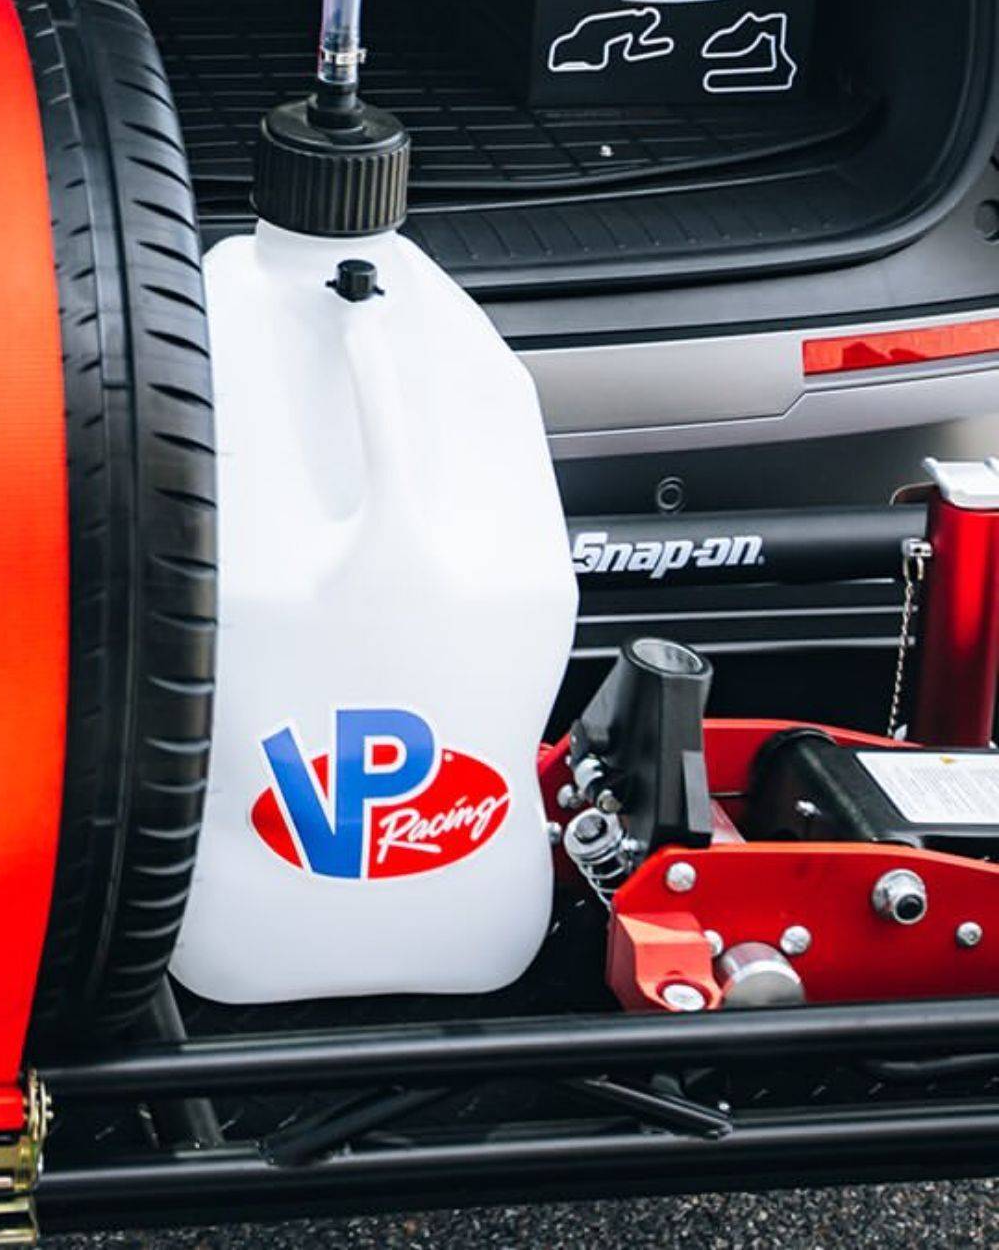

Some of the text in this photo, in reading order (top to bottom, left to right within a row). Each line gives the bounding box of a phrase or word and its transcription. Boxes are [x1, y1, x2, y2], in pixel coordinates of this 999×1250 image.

[573, 532, 763, 579] Snap-on
[262, 709, 435, 879] VP
[376, 792, 509, 863] Racing
